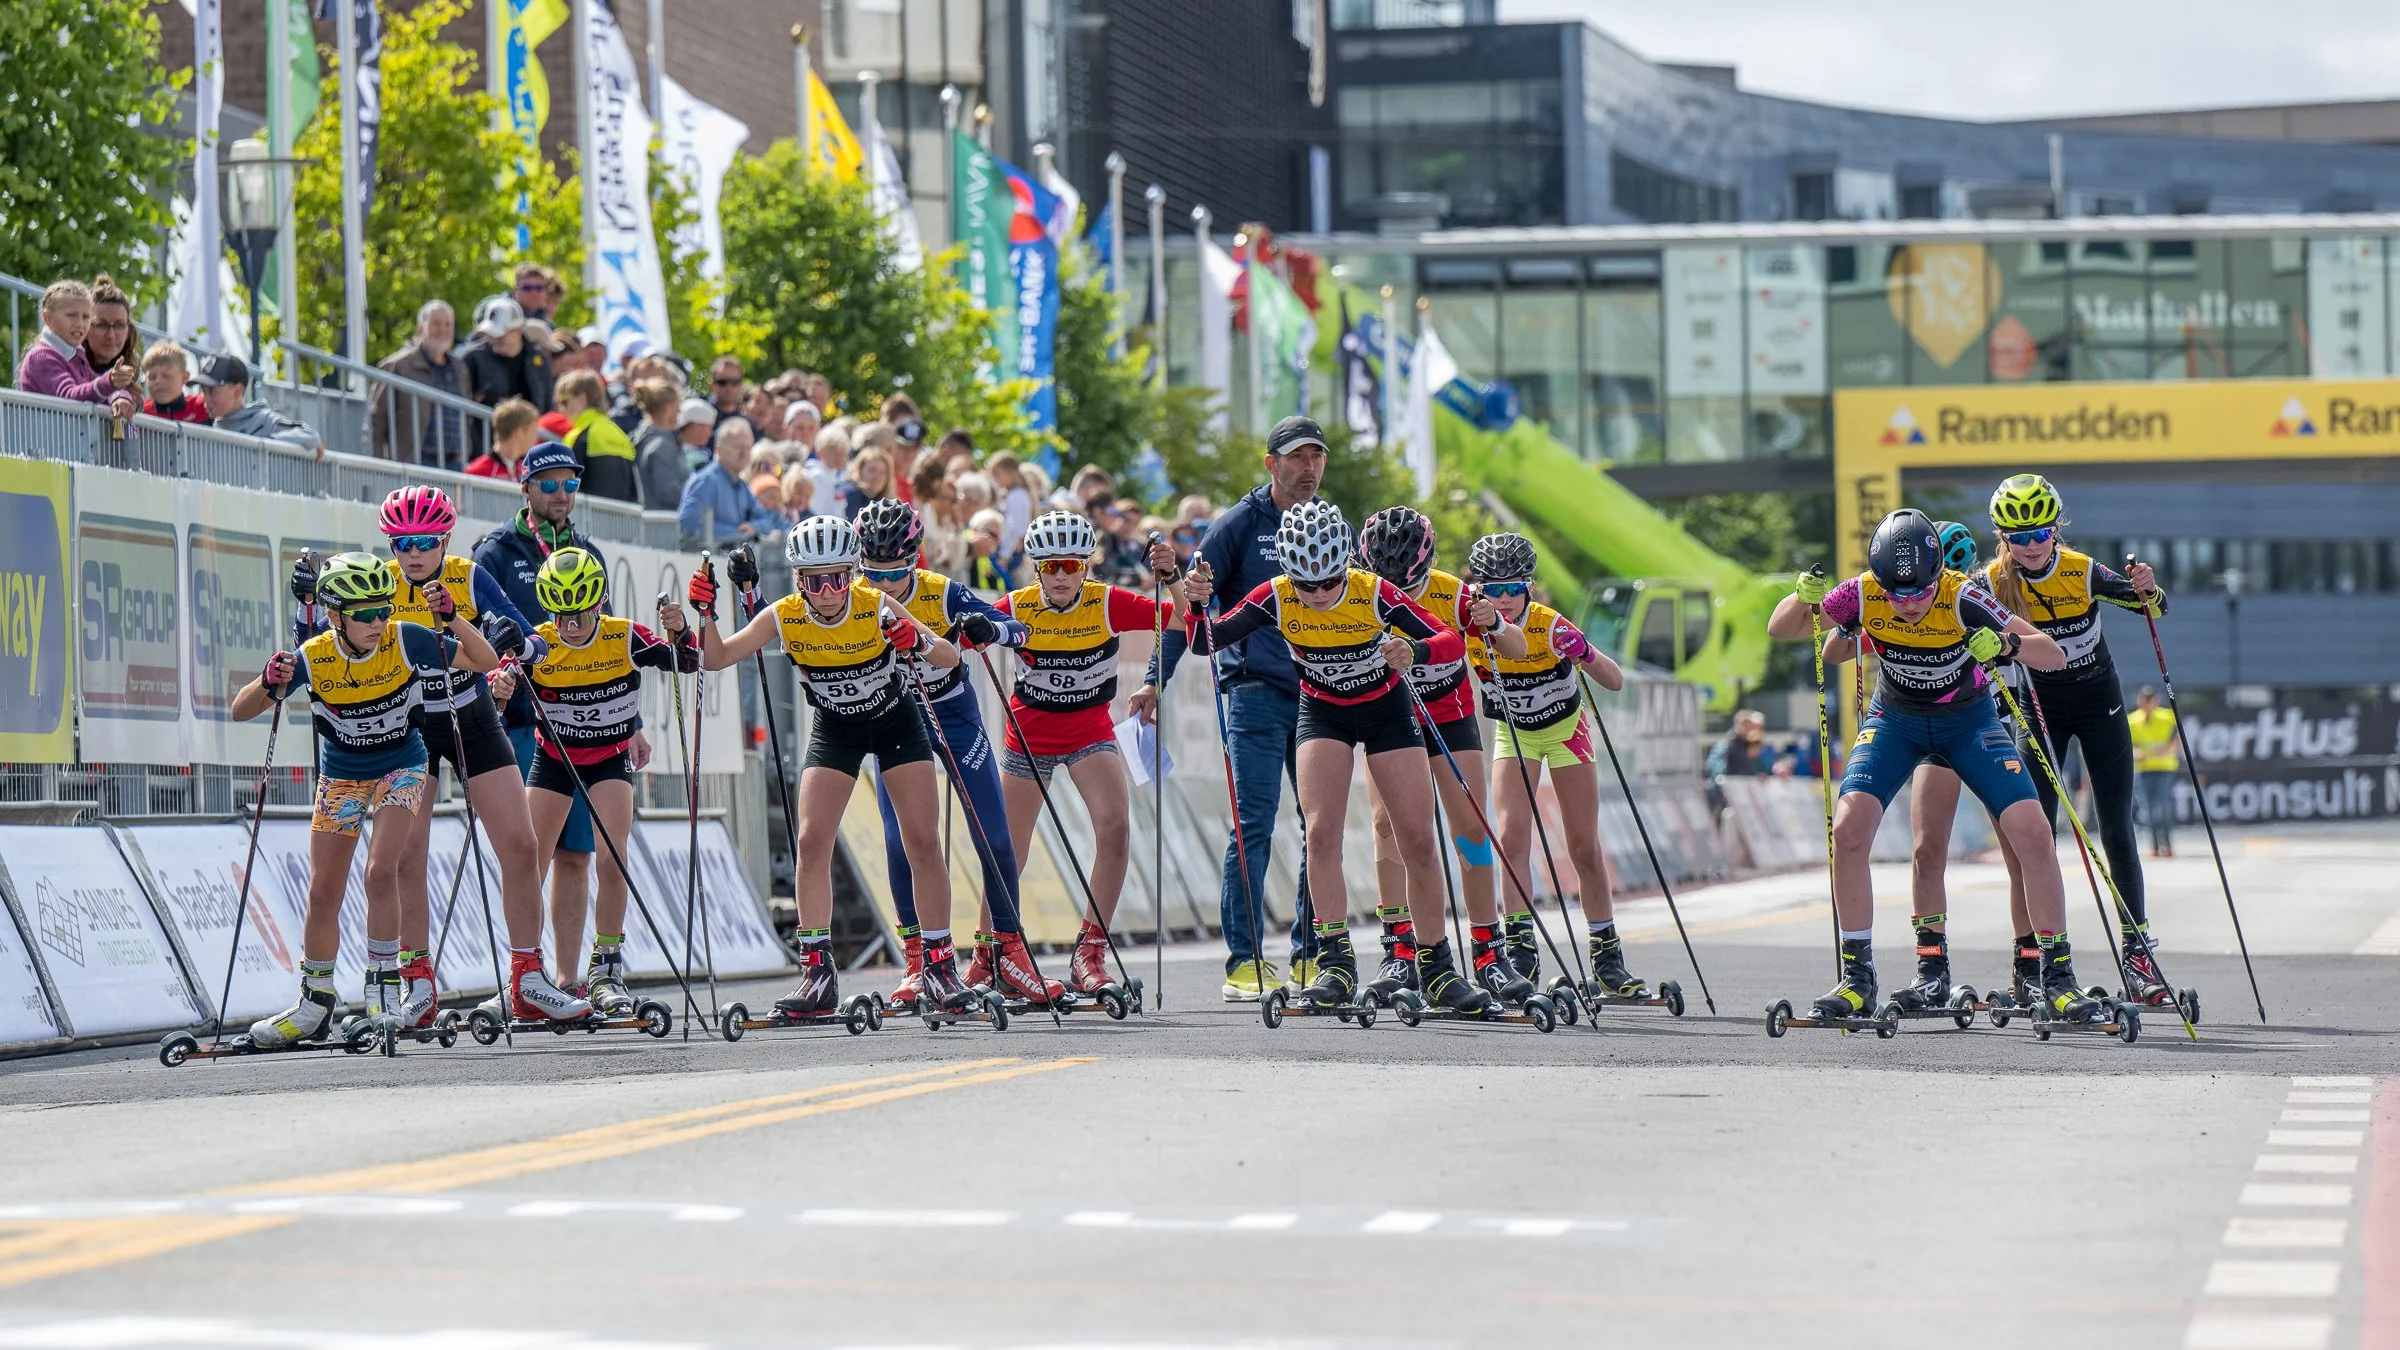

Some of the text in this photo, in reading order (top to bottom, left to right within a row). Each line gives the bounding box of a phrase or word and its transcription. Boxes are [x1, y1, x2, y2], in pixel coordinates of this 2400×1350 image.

[1939, 405, 2170, 443] Ramudden
[532, 454, 574, 467] CANYON
[1260, 548, 1277, 556] Øste
[1083, 598, 1101, 607] coop
[1430, 592, 1453, 600] coop
[1017, 601, 1038, 609] coop
[1934, 602, 1952, 610] coop
[783, 617, 807, 626] coop
[854, 611, 875, 620] coop
[1053, 627, 1071, 635] Gule
[1072, 625, 1101, 634] Banken
[1320, 623, 1341, 631] Gule
[1887, 622, 1903, 631] Den
[1904, 626, 1924, 634] Gule
[2042, 618, 2089, 636] ÆVELAND
[602, 632, 625, 641] coop
[380, 638, 395, 653] coop
[806, 637, 877, 652] Den Gule Banken
[313, 656, 336, 664] coop
[574, 663, 593, 671] Gule
[594, 658, 624, 668] Banken
[375, 665, 401, 682] Banken
[1323, 664, 1355, 676] 62
[1049, 673, 1076, 689] 68
[1500, 671, 1557, 687] KJÆVELAND
[827, 683, 859, 698] 58
[1024, 684, 1100, 703] Multiconsult
[1509, 695, 1535, 709] 57
[572, 708, 601, 722] 52
[357, 718, 386, 732] 51
[2180, 706, 2359, 760] terHus
[961, 726, 983, 765] Stavang
[2172, 768, 2376, 821] ticonsult
[73, 888, 142, 932] SANDNES
[409, 992, 434, 1016] alpina
[522, 988, 565, 1008] alpina
